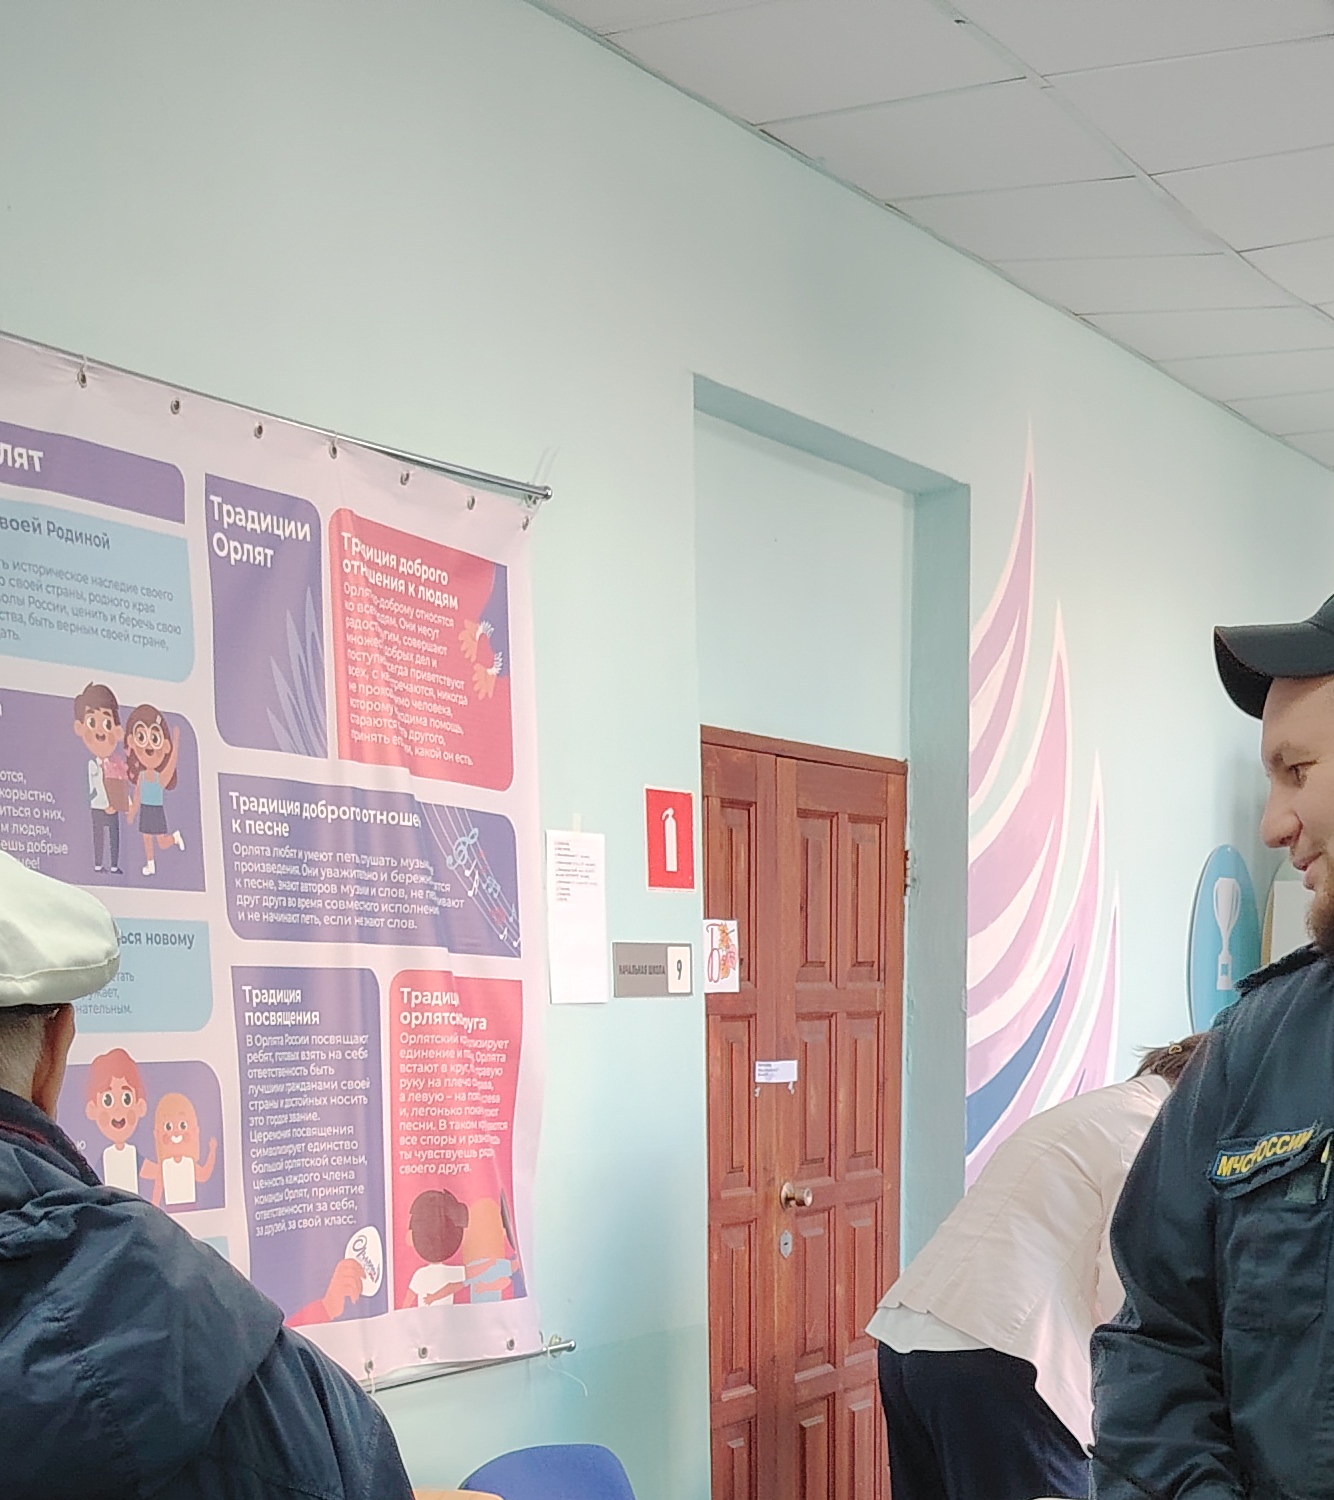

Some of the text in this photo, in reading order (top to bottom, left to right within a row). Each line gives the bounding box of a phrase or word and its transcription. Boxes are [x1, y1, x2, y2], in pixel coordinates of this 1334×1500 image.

[209, 495, 311, 542] Традиции
[46, 520, 111, 550] Родиной
[212, 532, 274, 568] Орлят
[399, 557, 449, 586] доброго
[12, 560, 89, 585] историческое
[91, 577, 139, 595] наследие
[140, 585, 174, 602] своего
[9, 575, 43, 592] своей
[88, 591, 131, 609] родного
[132, 600, 155, 614] края
[408, 582, 416, 597] к
[418, 585, 458, 610] людям
[28, 612, 55, 630] быть
[228, 791, 301, 817] Традиция
[302, 800, 361, 823] доброго
[231, 819, 290, 837] к песне
[27, 842, 68, 855] добрые
[232, 842, 271, 858] Орлята
[146, 932, 195, 950] новому
[676, 959, 682, 980] 9
[241, 985, 302, 1007] Традиция
[399, 987, 460, 1008] Традиц
[244, 1011, 320, 1028] посвящения
[399, 1032, 459, 1046] Орлятский
[399, 1049, 455, 1060] единение
[399, 1063, 439, 1073] встают
[411, 1106, 463, 1117] легонько
[307, 1140, 358, 1154] единство
[420, 1135, 457, 1147] споры
[414, 1149, 478, 1162] чувствуешь
[399, 1164, 436, 1174] своего
[1217, 1154, 1252, 1177] МЧС
[322, 1170, 355, 1181] члена
[311, 1184, 365, 1198] принятие
